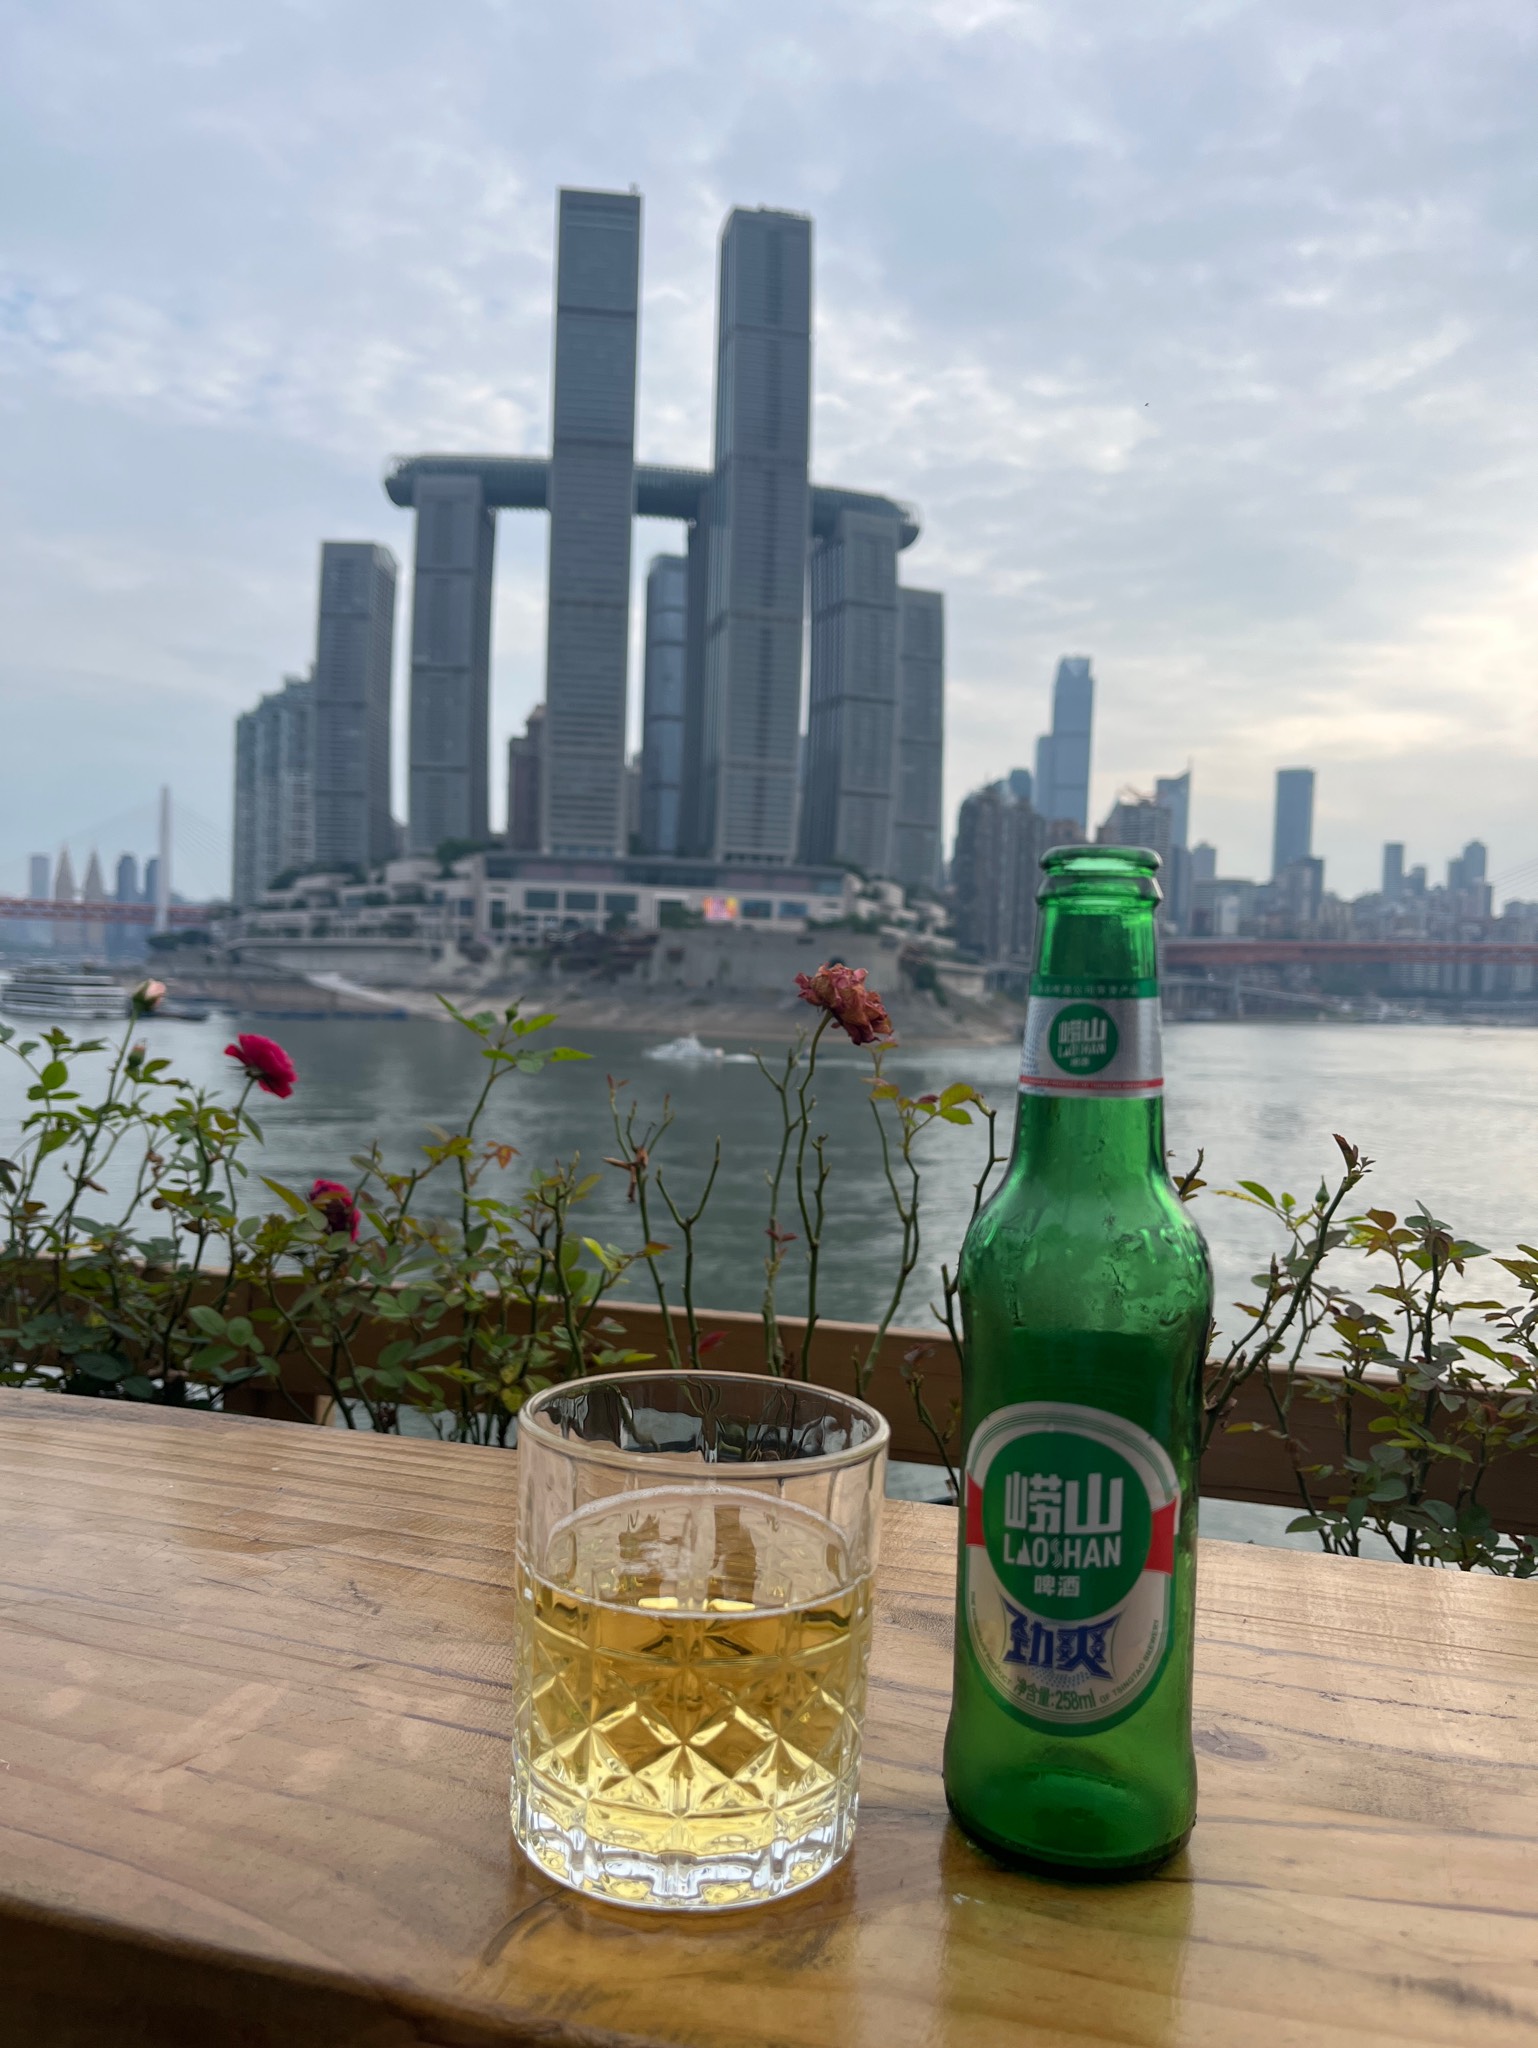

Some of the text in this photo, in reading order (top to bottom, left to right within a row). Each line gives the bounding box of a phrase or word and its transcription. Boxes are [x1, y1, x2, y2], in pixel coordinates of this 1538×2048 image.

[1003, 1471, 1123, 1535] 崂山
[1003, 1533, 1122, 1569] LAOSHAN
[1033, 1574, 1081, 1598] 啤酒
[1001, 1597, 1121, 1679] 劲爽
[1099, 1694, 1111, 1704] OF
[1112, 1662, 1145, 1696] TSINGTAO
